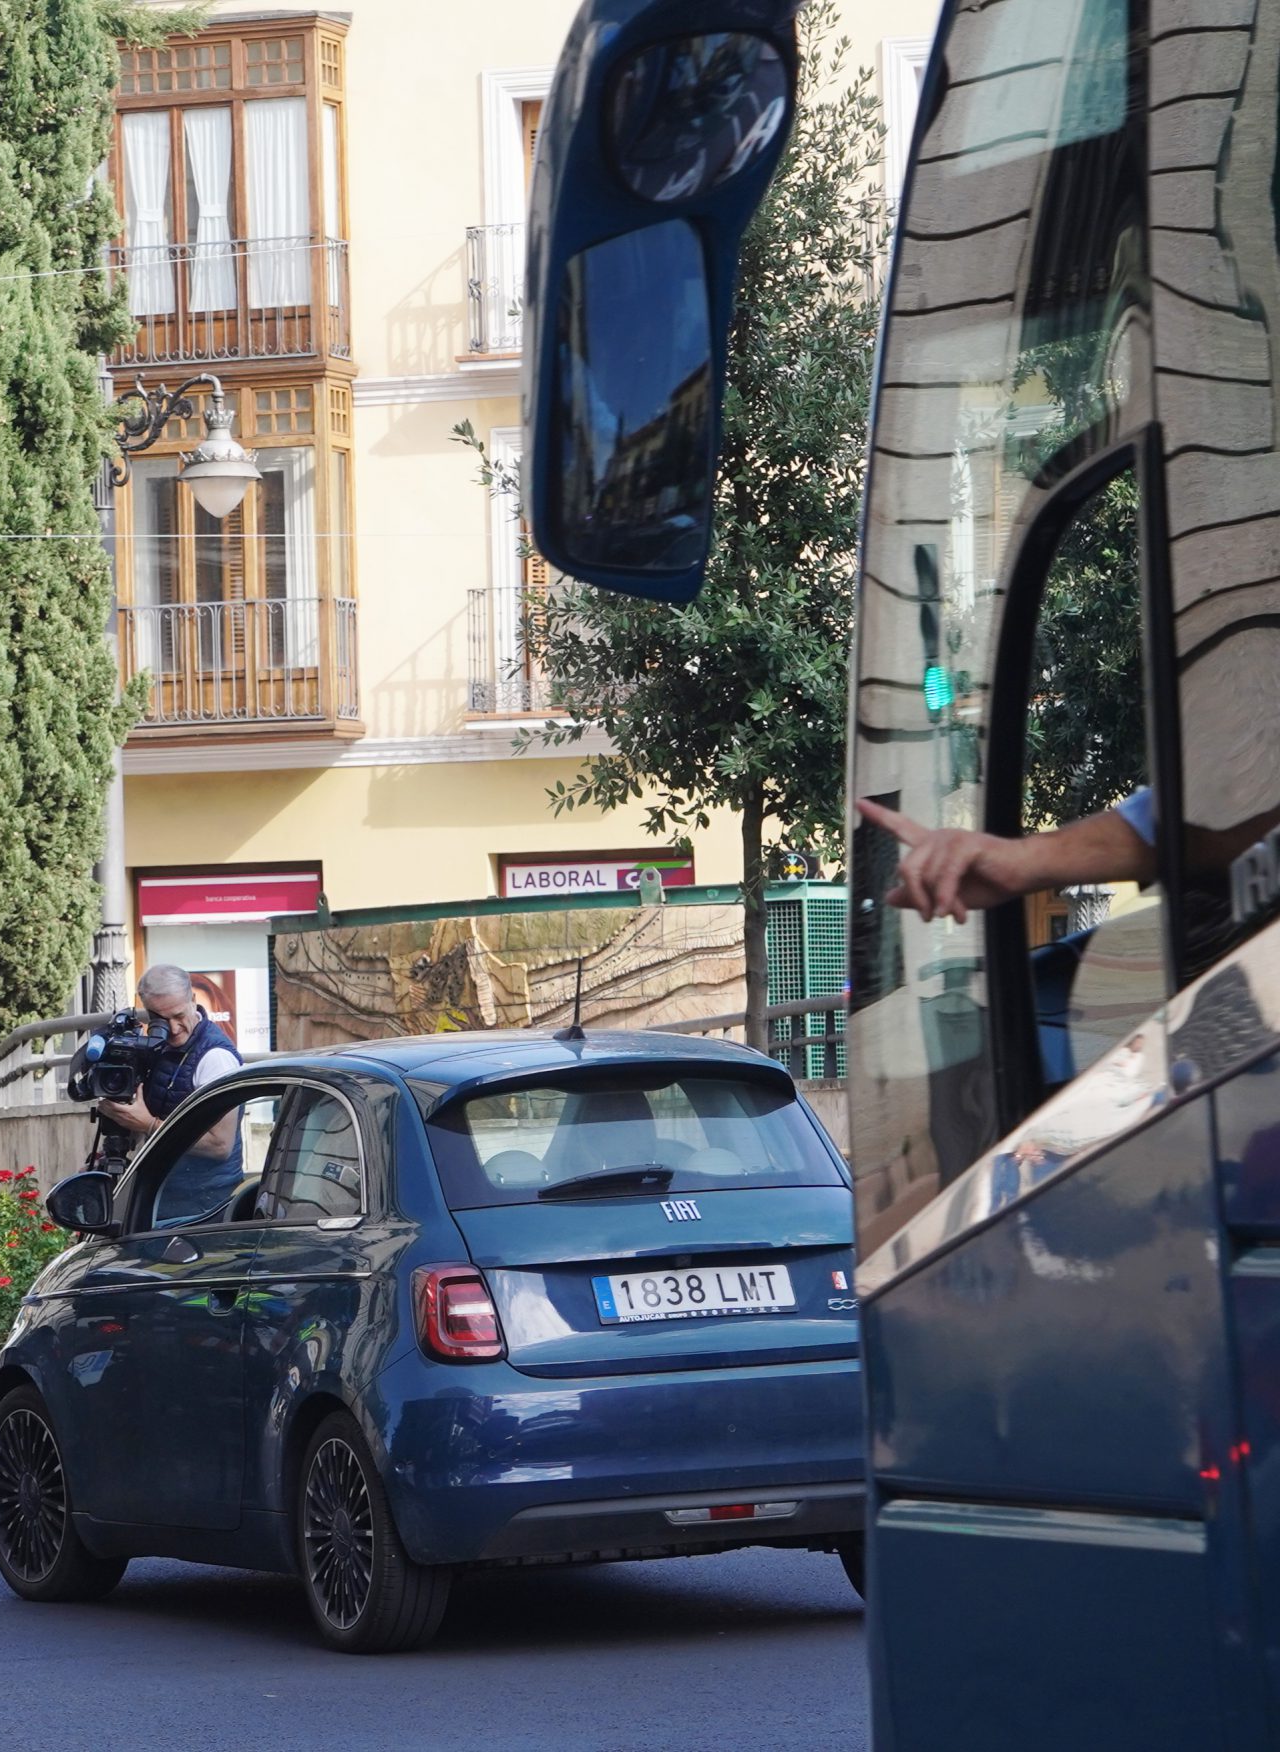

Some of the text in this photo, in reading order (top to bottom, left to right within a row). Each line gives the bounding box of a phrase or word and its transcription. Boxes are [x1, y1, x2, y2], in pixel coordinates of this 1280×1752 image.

[511, 869, 607, 889] LABORAL
[244, 1026, 269, 1035] HIPOT
[660, 1200, 702, 1221] FIAT
[621, 1271, 775, 1310] 1838 LMT
[602, 1301, 611, 1310] E
